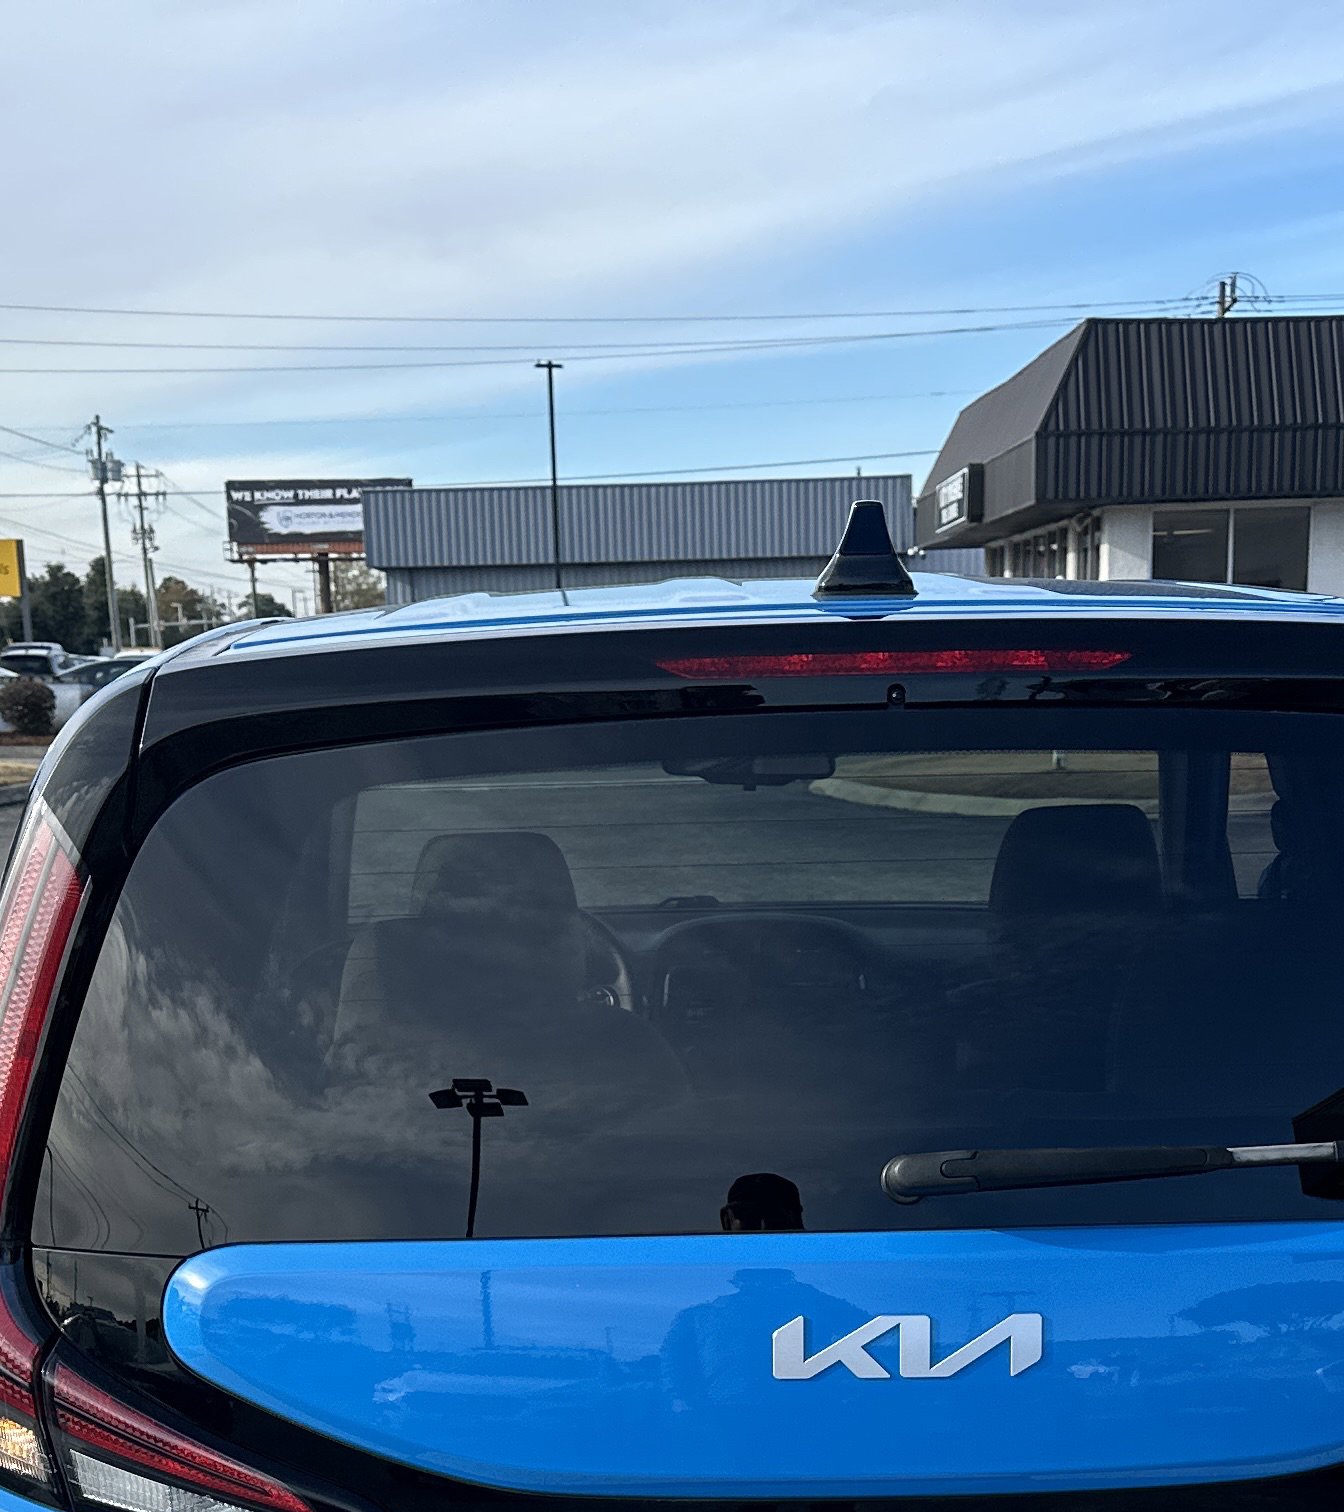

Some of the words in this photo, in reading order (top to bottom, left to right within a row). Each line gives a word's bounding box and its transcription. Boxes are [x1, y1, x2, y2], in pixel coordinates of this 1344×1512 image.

[230, 490, 252, 501] WE
[254, 489, 294, 501] KNOW
[297, 488, 333, 500] THEIR
[772, 1313, 1043, 1380] KIA
